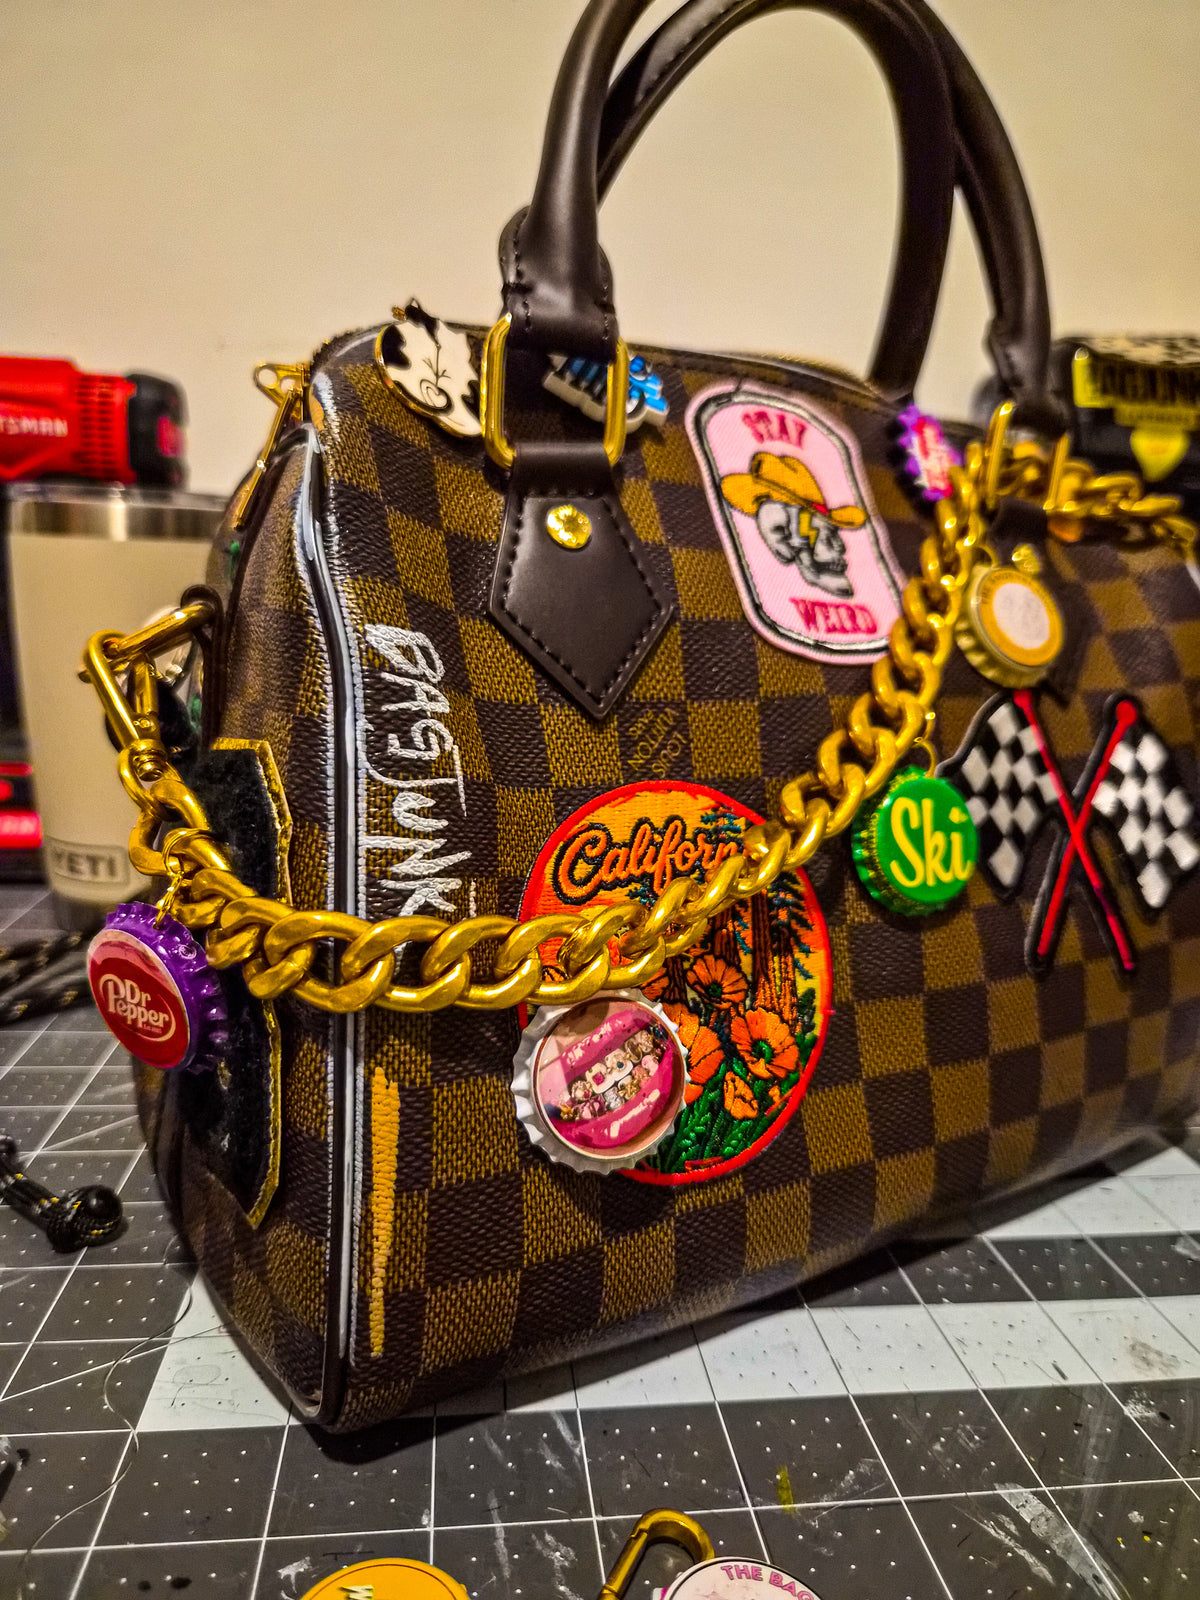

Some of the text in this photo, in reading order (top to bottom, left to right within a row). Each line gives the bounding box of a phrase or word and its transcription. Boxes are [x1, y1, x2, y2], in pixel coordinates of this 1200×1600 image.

[627, 707, 680, 772] VUITTON
[652, 731, 687, 779] LOUIS
[52, 847, 117, 878] YETI
[552, 814, 746, 905] Californ
[890, 797, 977, 888] Ski
[100, 974, 170, 1028] Pepper
[124, 979, 151, 1007] Dr
[721, 1564, 763, 1581] THE
